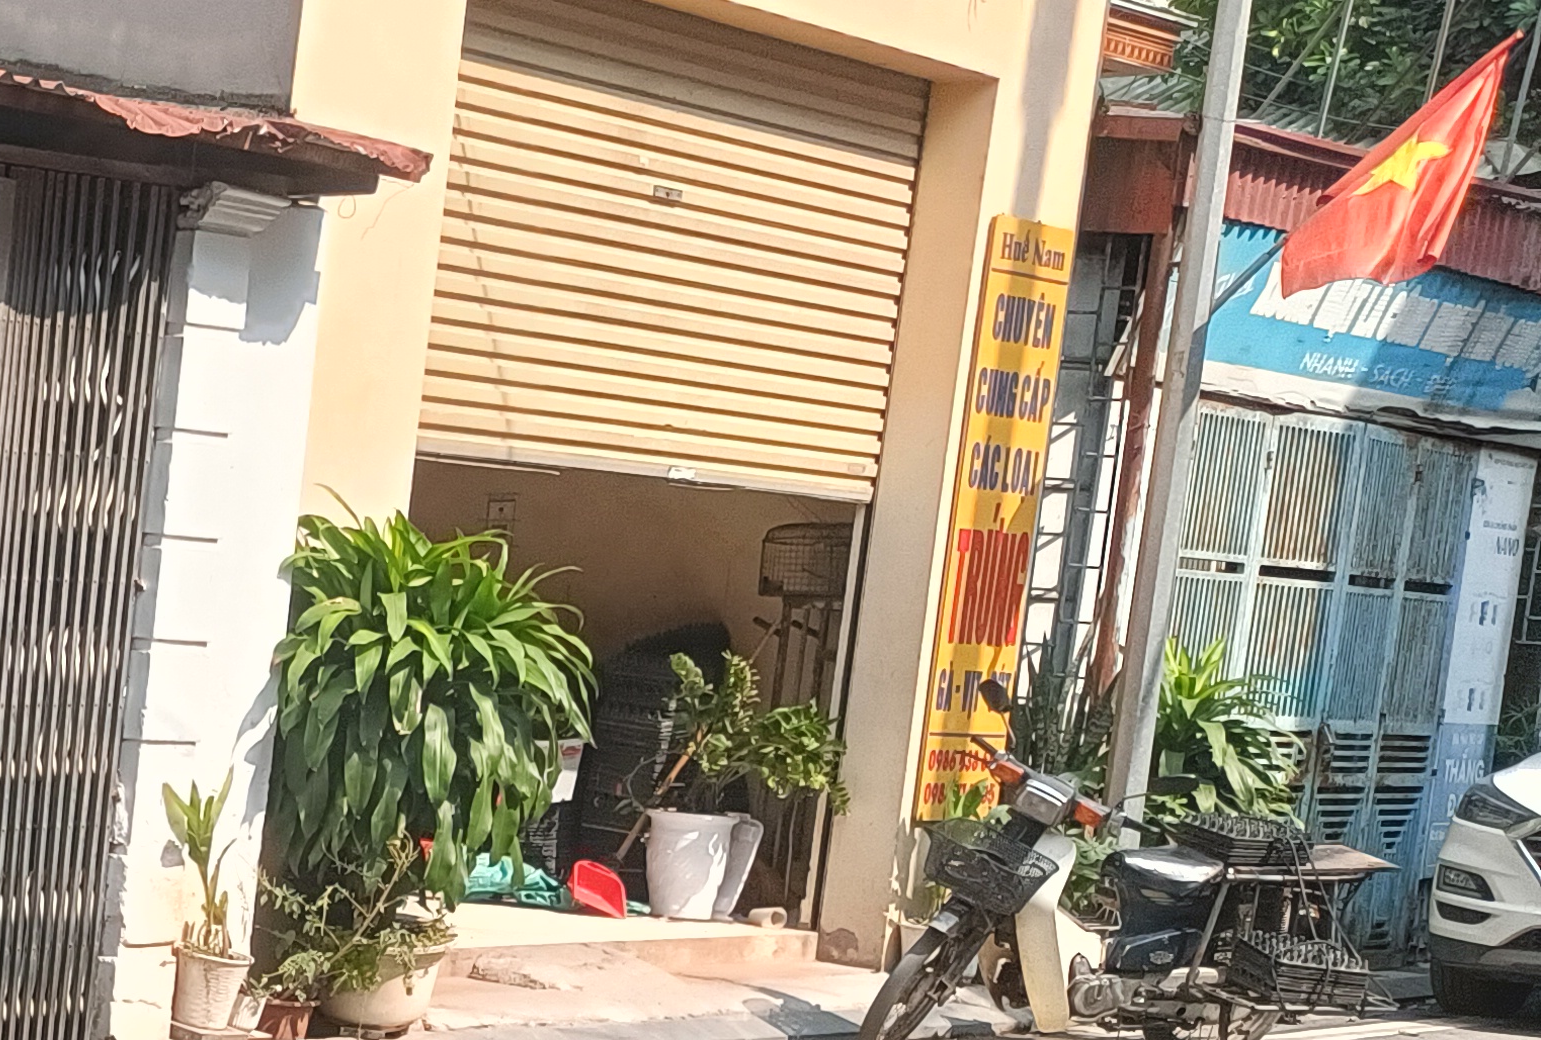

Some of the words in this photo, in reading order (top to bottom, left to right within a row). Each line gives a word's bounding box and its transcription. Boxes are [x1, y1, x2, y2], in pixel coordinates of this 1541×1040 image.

[1031, 238, 1065, 271] Nam
[992, 292, 1056, 350] CHUYÊN
[975, 366, 1019, 418] CUNG
[1018, 361, 1051, 423] CẤP
[968, 434, 1001, 490] CÁC
